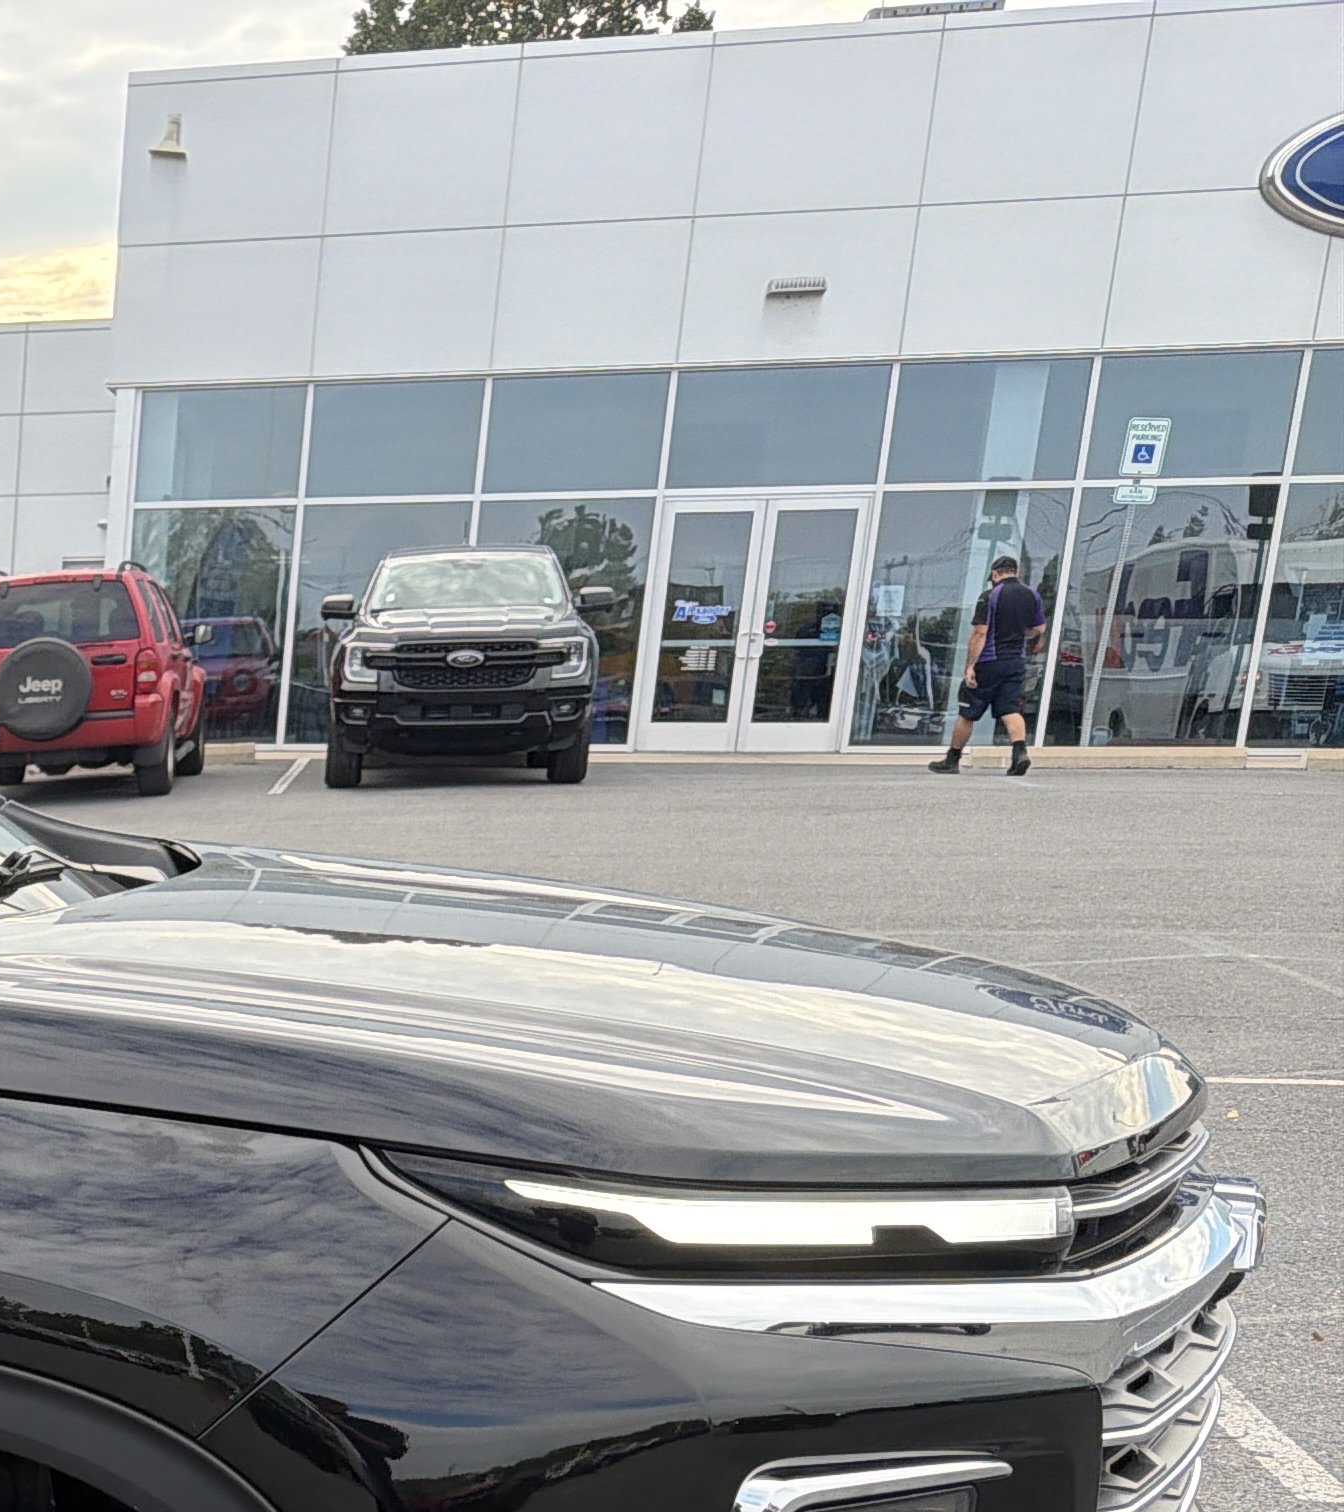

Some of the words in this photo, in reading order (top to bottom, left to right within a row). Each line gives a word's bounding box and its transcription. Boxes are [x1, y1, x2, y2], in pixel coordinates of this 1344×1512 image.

[1130, 423, 1167, 432] RESERVED
[1131, 433, 1163, 441] PARKING
[18, 676, 63, 694] Jeep
[17, 695, 62, 704] LIBERTY
